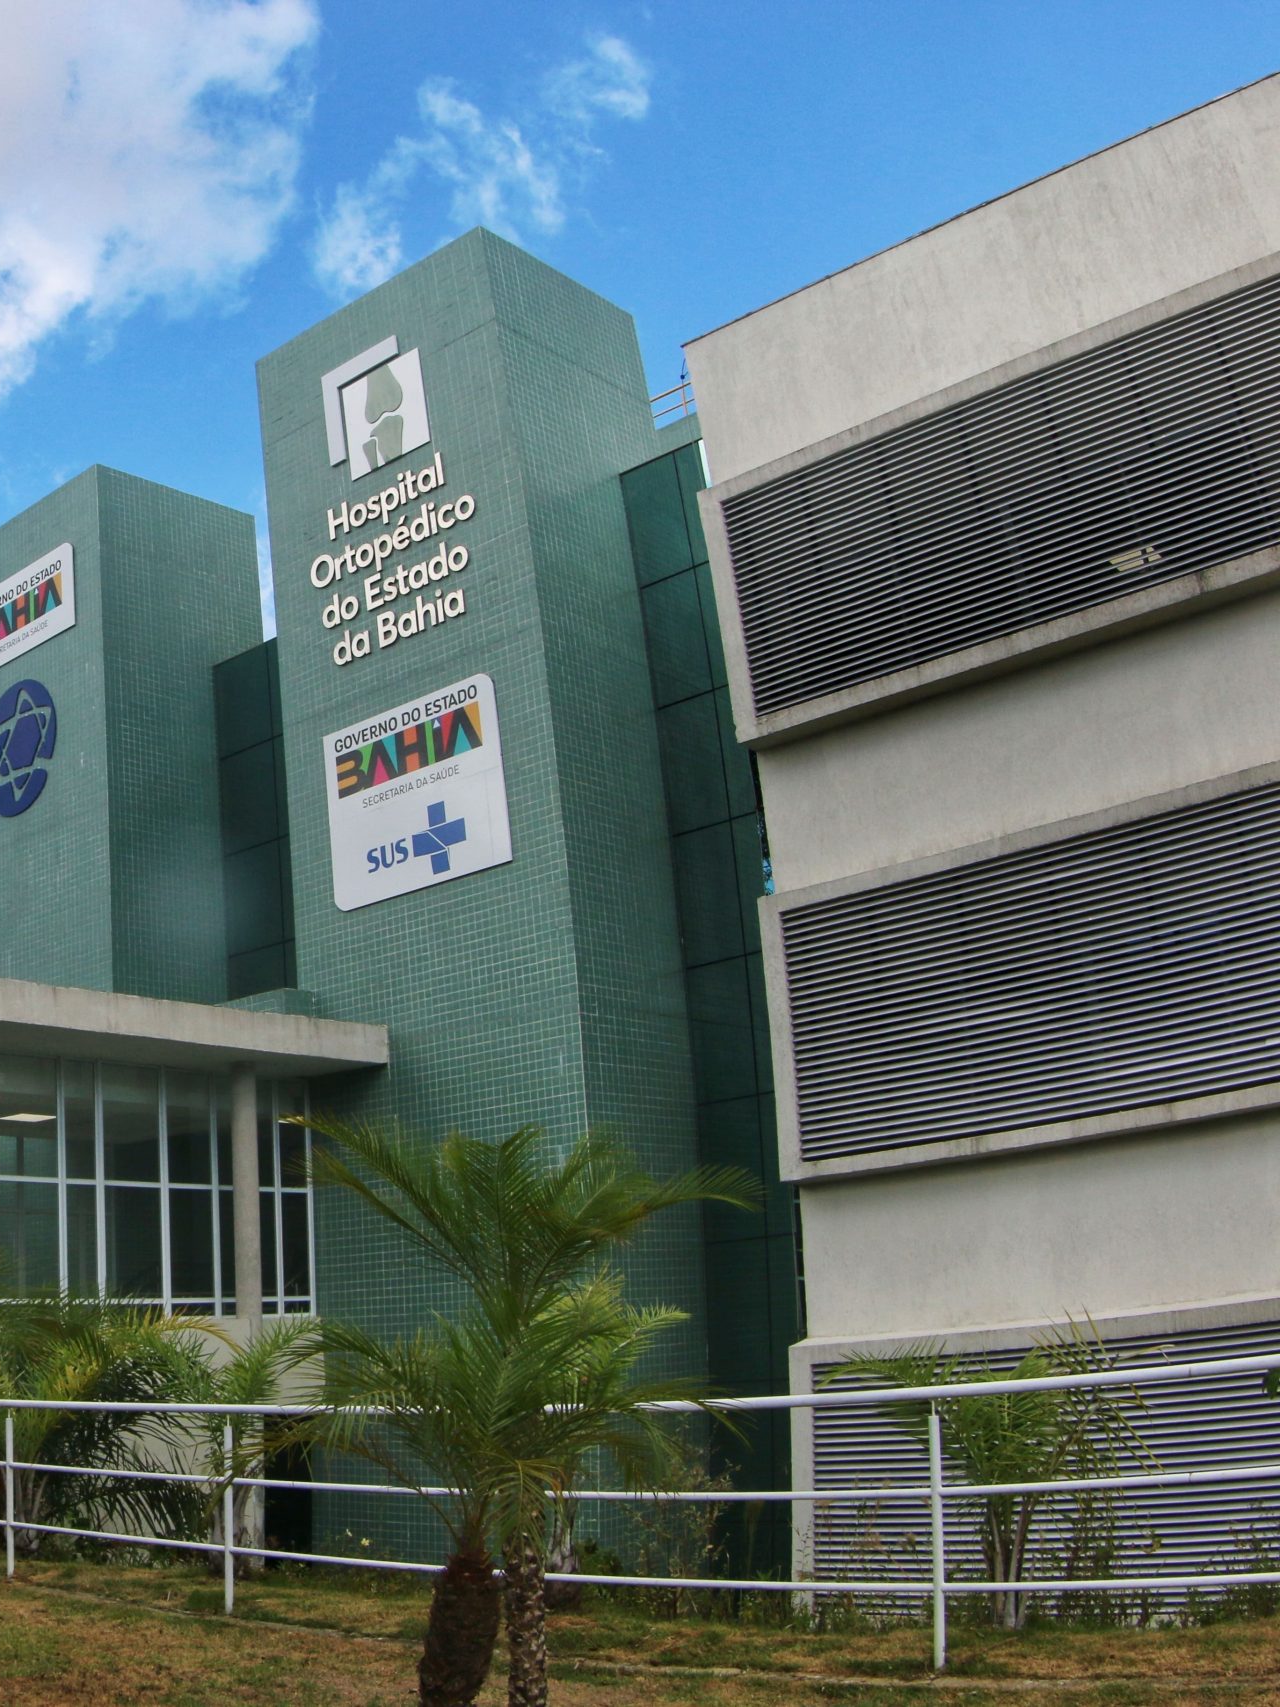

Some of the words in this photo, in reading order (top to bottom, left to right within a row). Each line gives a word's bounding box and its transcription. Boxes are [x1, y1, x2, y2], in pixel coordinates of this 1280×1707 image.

[327, 451, 446, 540] Hospital
[16, 580, 29, 596] DO
[30, 559, 62, 587] ESTADO
[310, 494, 475, 588] Ortopédico
[322, 593, 359, 629] do
[364, 541, 468, 611] Estado
[21, 631, 30, 643] DA
[333, 630, 371, 666] da
[376, 588, 466, 648] Bahia
[334, 716, 398, 753] GOVERNO
[401, 707, 421, 728] DO
[424, 684, 478, 717] ESTADO
[336, 701, 483, 799] BAHIA
[362, 783, 414, 809] SECRETARIA
[416, 776, 428, 789] DA
[429, 764, 460, 785] SAÚDE
[366, 838, 409, 874] SUS
